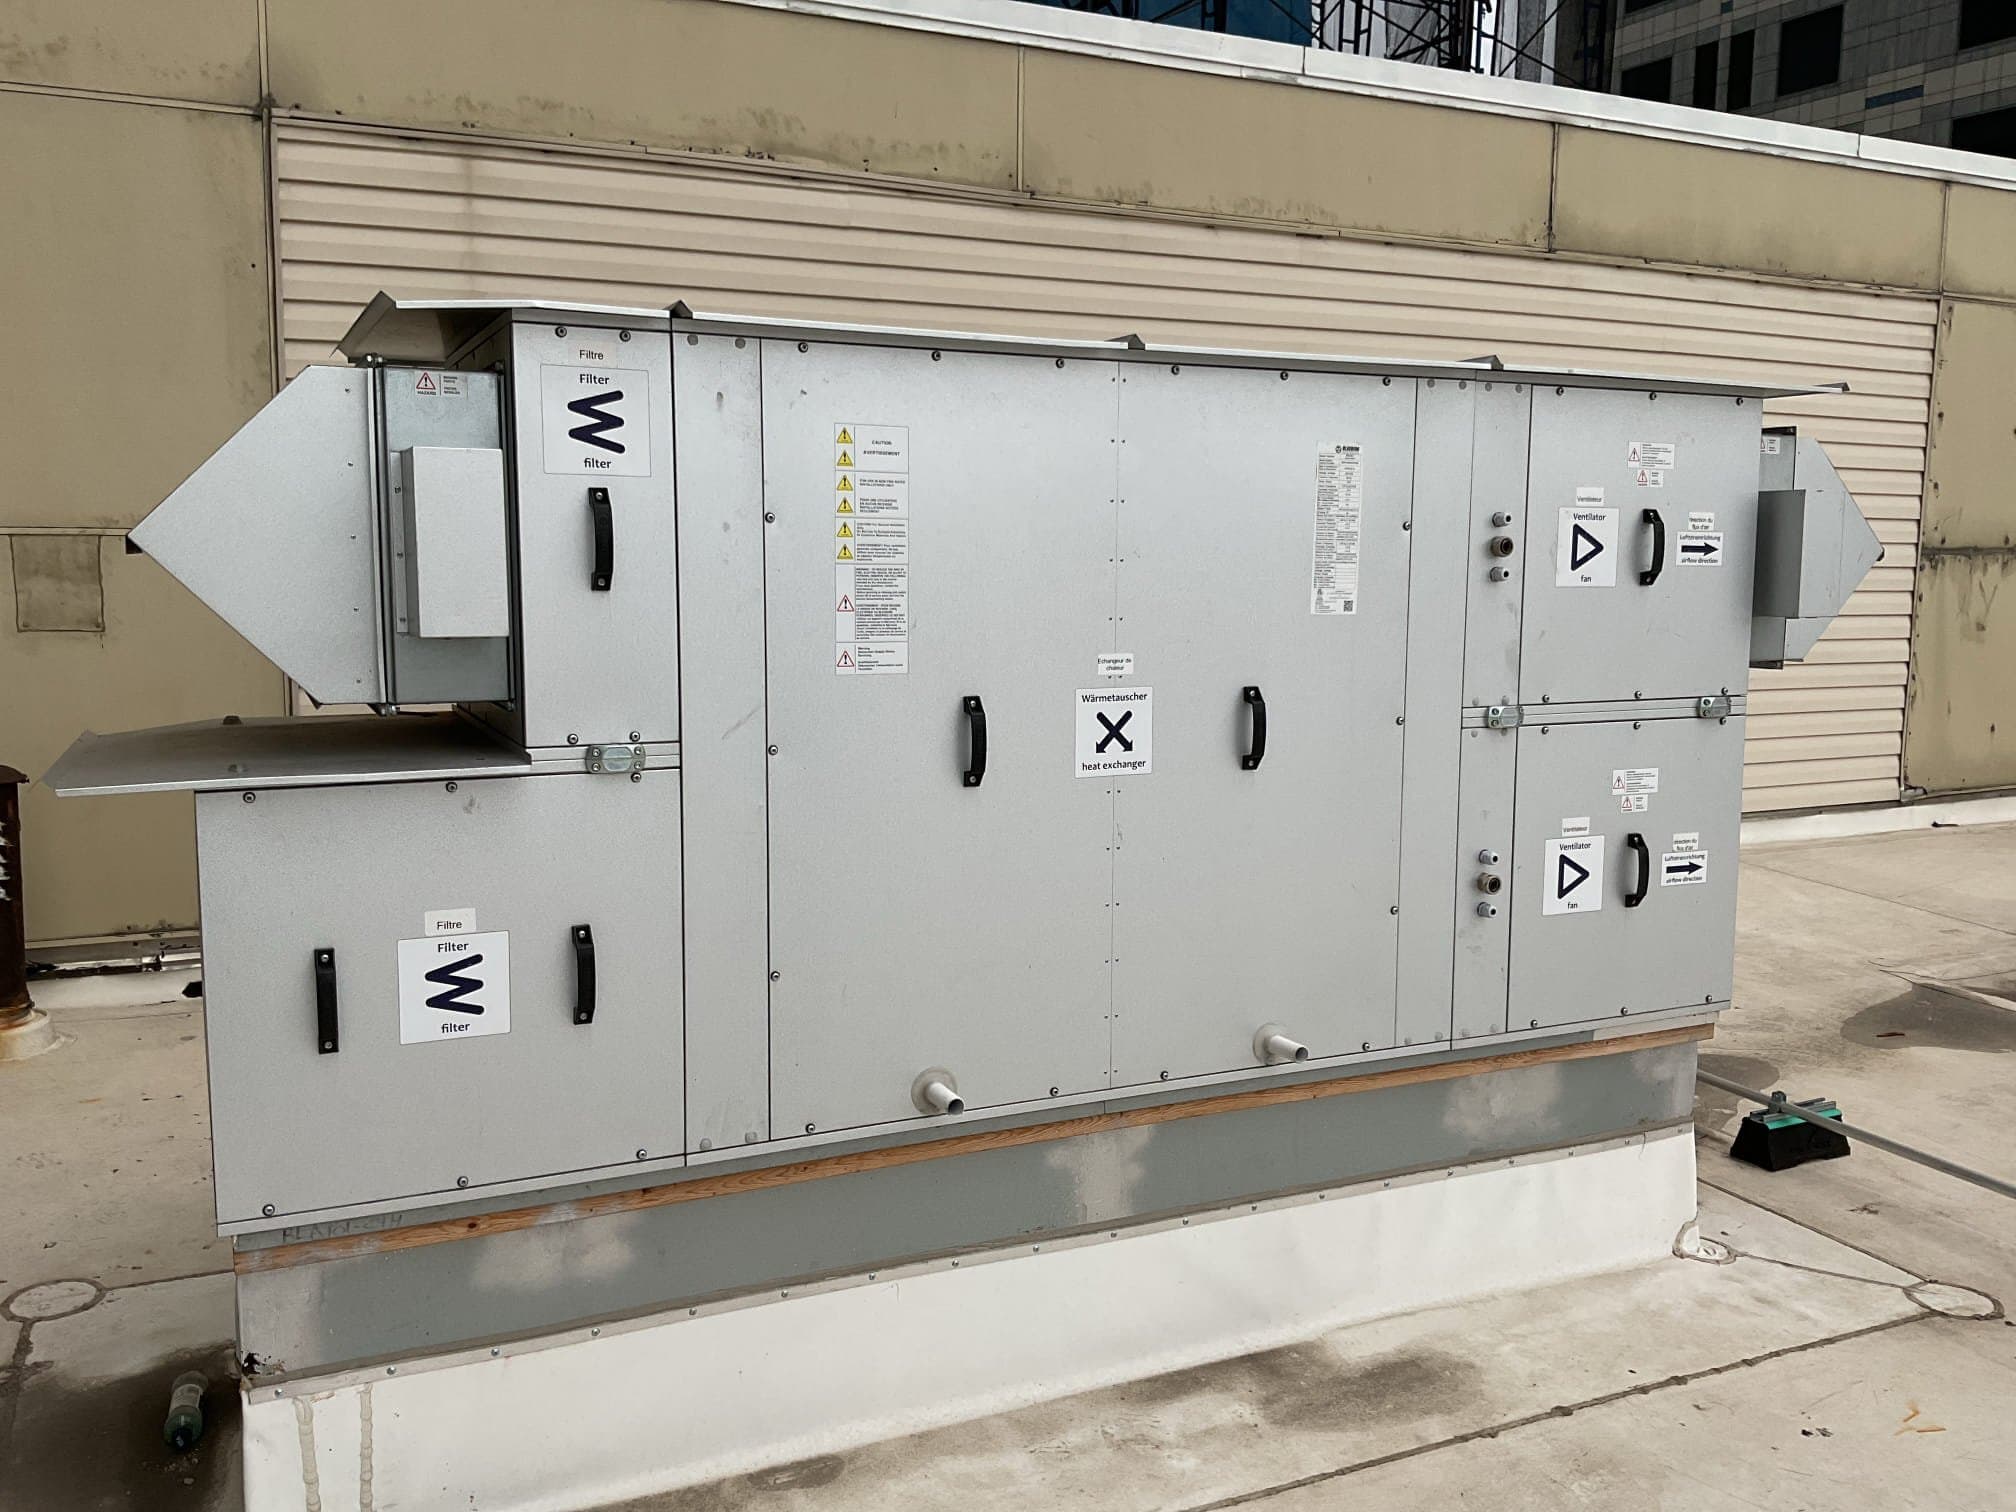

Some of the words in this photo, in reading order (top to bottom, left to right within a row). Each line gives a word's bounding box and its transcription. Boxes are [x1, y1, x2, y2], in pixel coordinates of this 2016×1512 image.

[579, 349, 604, 360] Filtre
[579, 373, 610, 385] Filter
[584, 457, 612, 469] filter
[1573, 512, 1607, 521] Ventilator
[1580, 574, 1592, 583] fan
[1081, 692, 1148, 703] Wärmetauscher
[1081, 762, 1101, 772] heat
[1102, 760, 1147, 771] exchanger
[1559, 842, 1592, 851] Ventilator
[1567, 901, 1578, 910] fan
[437, 920, 463, 931] Filtre
[437, 941, 470, 953] Filter
[441, 1022, 471, 1034] filter
